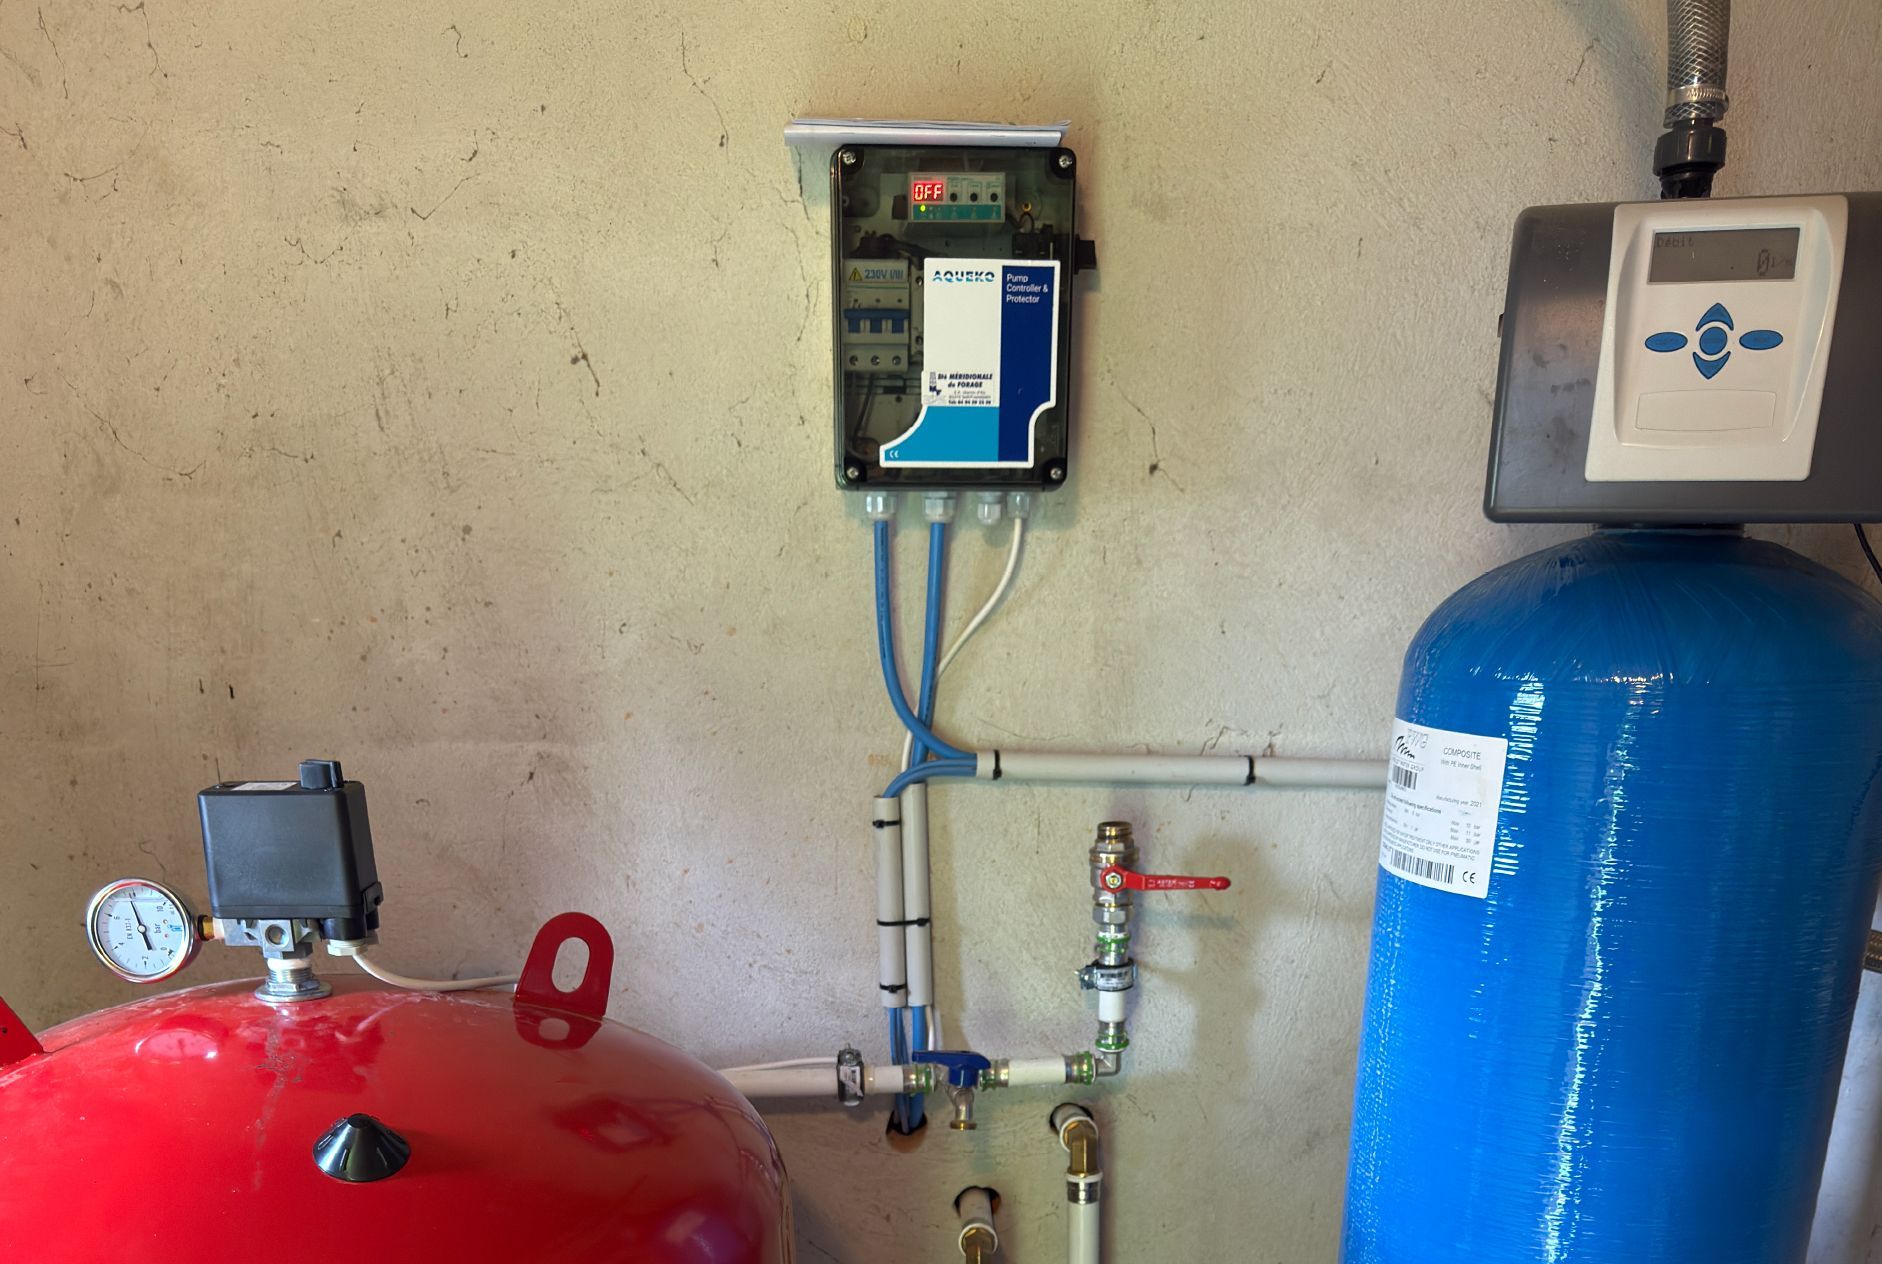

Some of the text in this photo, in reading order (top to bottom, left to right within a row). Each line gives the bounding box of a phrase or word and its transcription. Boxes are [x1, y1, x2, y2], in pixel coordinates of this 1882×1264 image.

[914, 184, 942, 200] OFF
[864, 269, 887, 279] 230V
[932, 270, 995, 283] AQUEKO
[1006, 273, 1029, 284] Pump
[1006, 284, 1049, 293] Controller &
[1006, 295, 1040, 303] Protector
[1443, 747, 1481, 760] COMPOSITE
